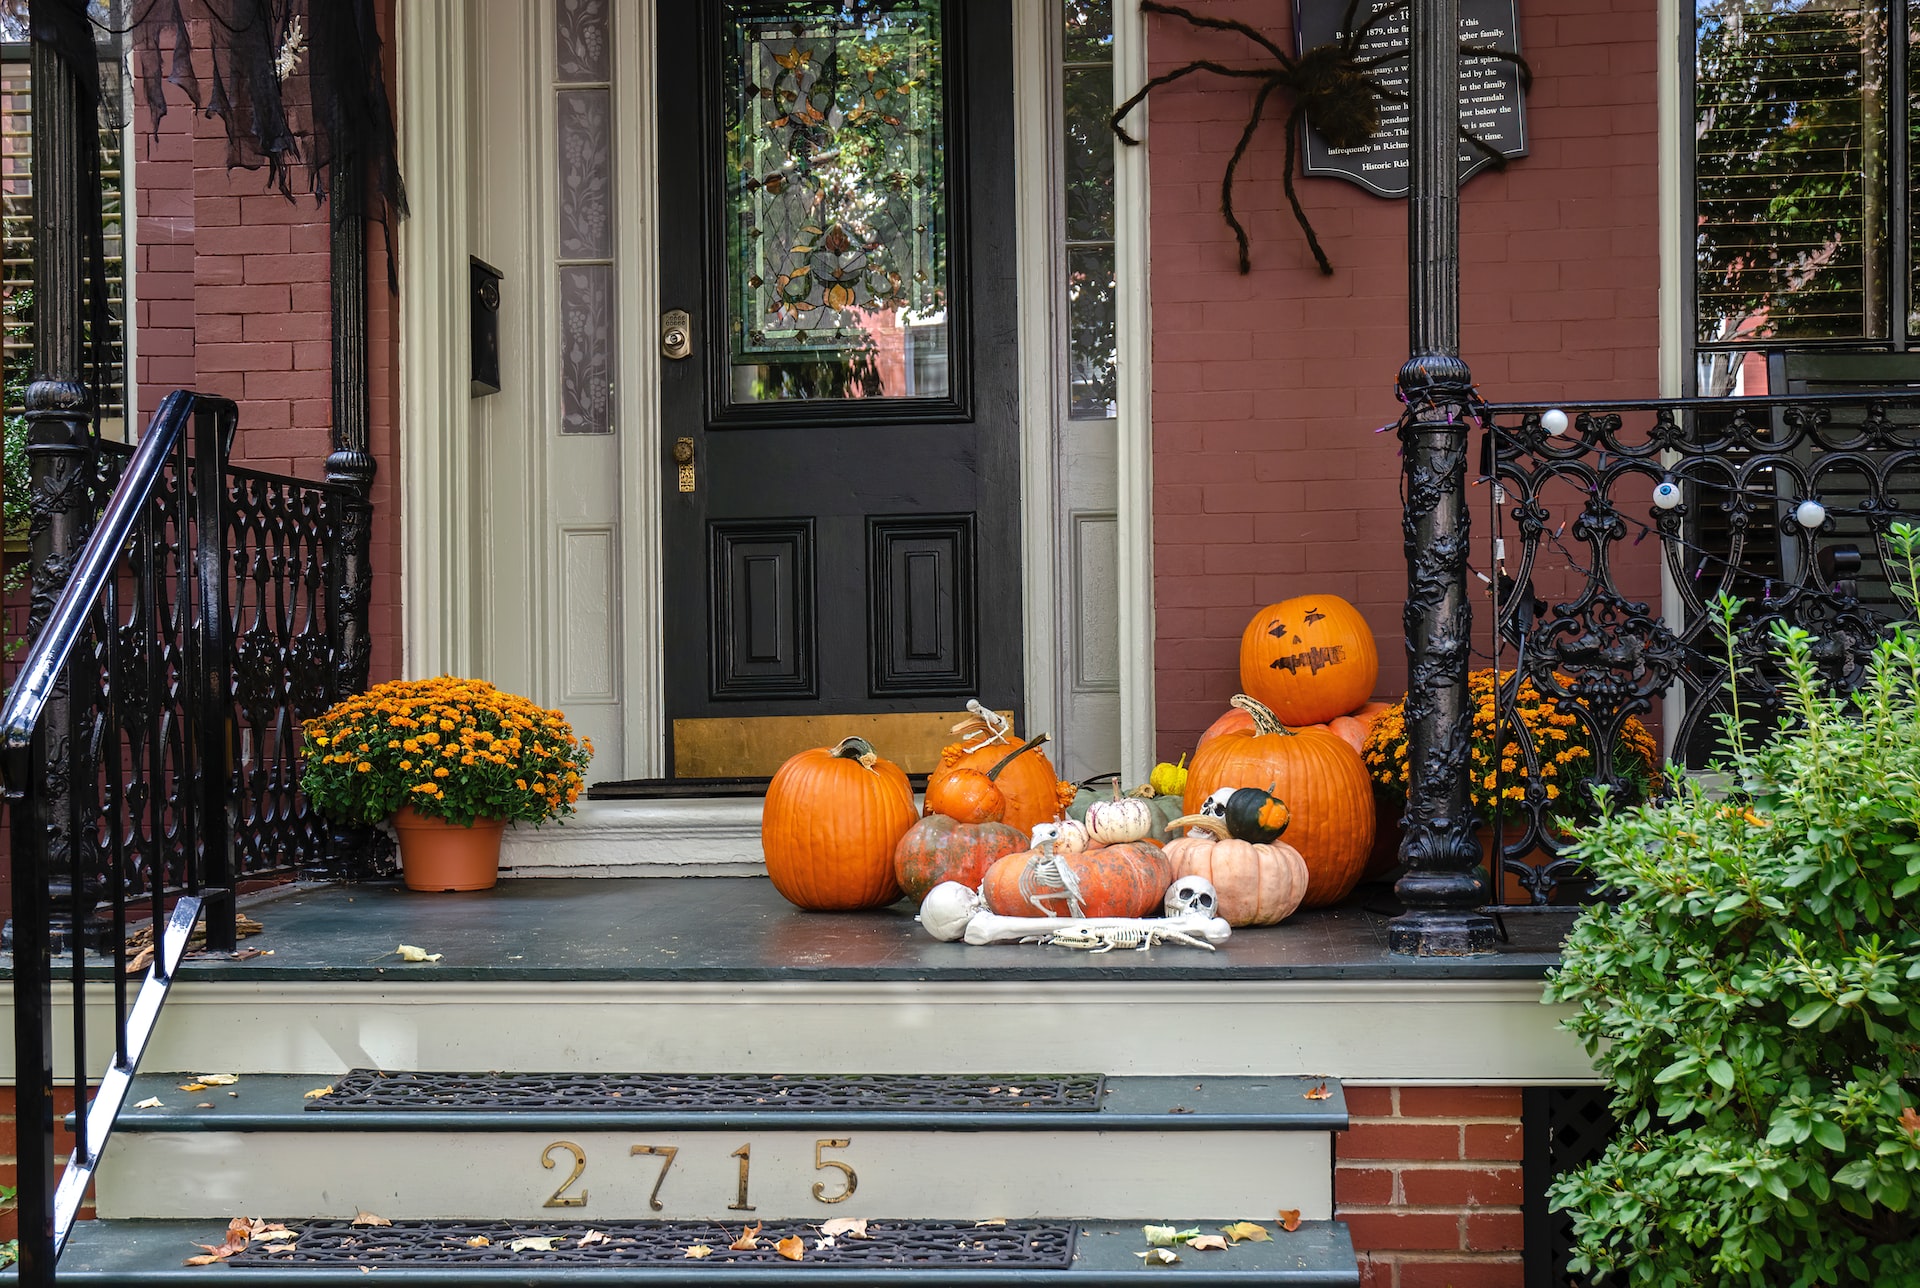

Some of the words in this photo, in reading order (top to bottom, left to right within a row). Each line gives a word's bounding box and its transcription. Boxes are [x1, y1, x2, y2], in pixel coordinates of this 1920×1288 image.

[1387, 26, 1399, 34] the
[1465, 18, 1479, 26] this
[1371, 41, 1389, 49] were
[1390, 39, 1403, 47] the
[1480, 28, 1505, 38] family.
[1464, 57, 1478, 66] and
[1381, 79, 1403, 87] home
[1473, 69, 1483, 79] by
[1484, 68, 1497, 76] the
[1469, 82, 1482, 91] the
[1483, 80, 1507, 90] family
[1380, 104, 1402, 112] home
[1471, 92, 1505, 104] verandah
[1460, 109, 1473, 119] just
[1474, 107, 1498, 117] below
[1499, 105, 1512, 114] the
[1471, 121, 1477, 130] is
[1479, 120, 1496, 129] seen
[1327, 144, 1373, 156] infrequently
[1373, 143, 1382, 152] in
[1484, 132, 1504, 141] time.
[1362, 161, 1392, 172] Historic
